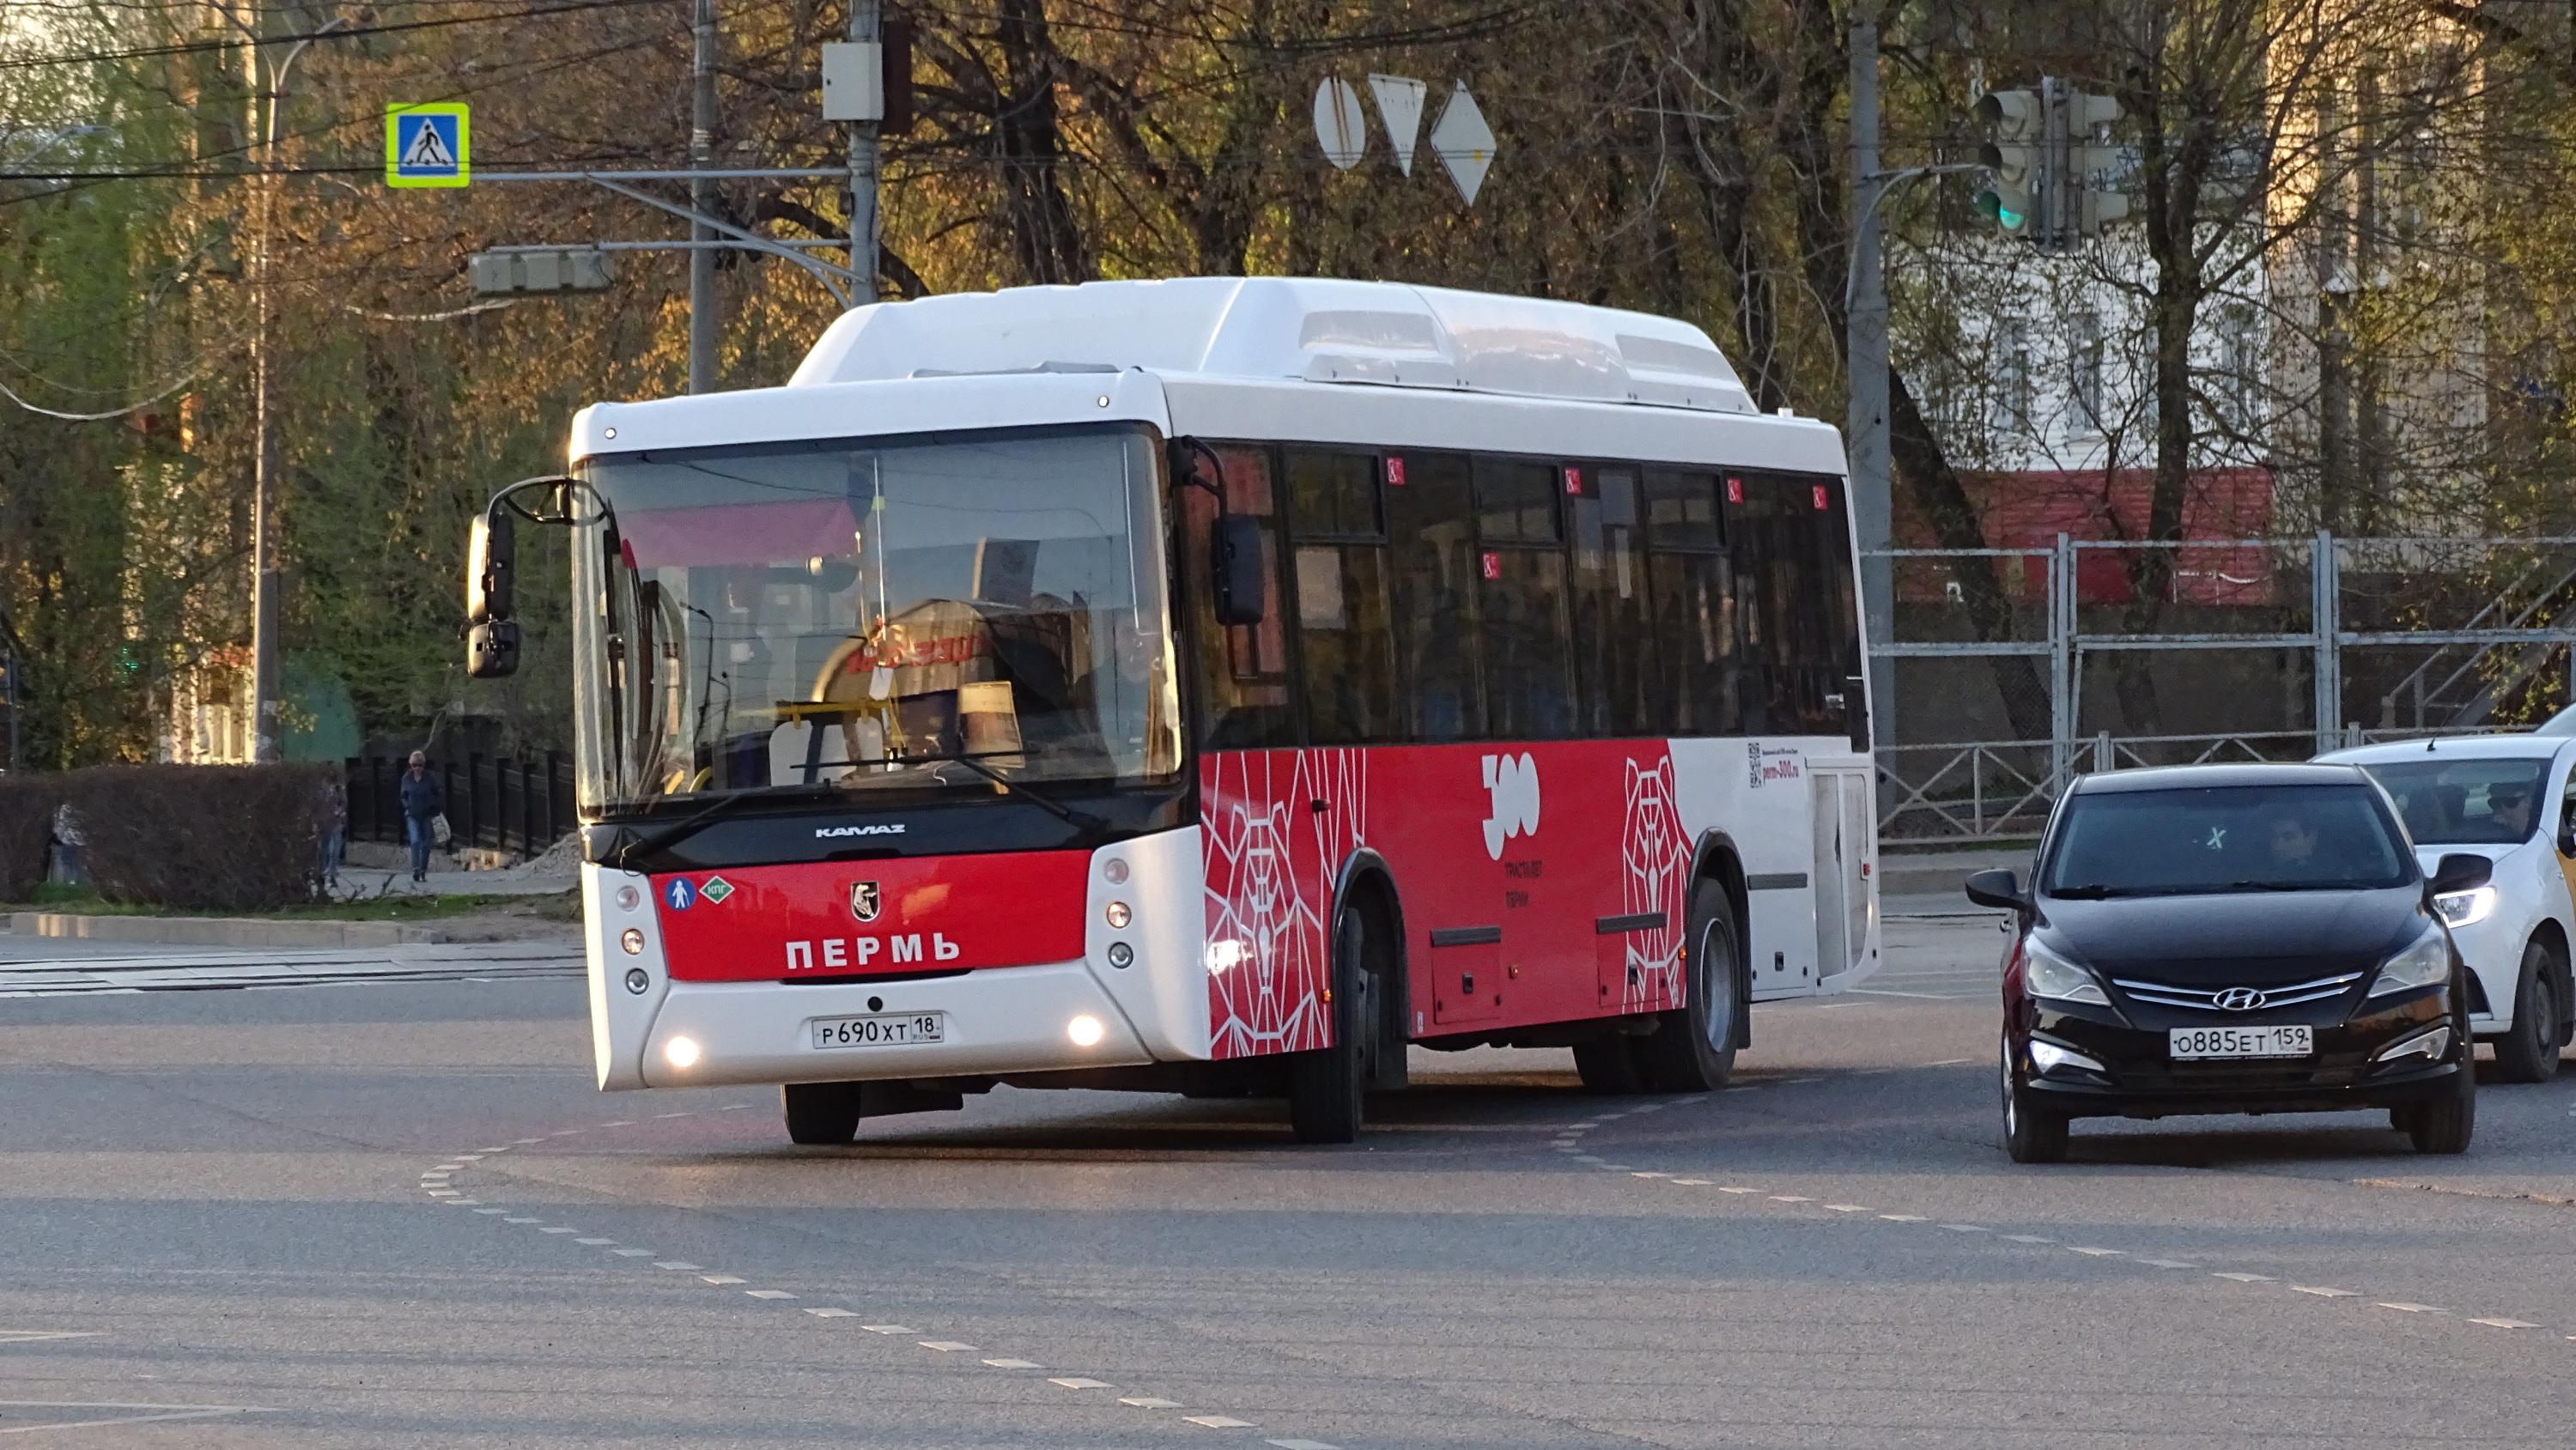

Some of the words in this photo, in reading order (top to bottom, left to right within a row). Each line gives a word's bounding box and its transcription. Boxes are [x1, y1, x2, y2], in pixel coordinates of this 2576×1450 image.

[816, 824, 905, 837] KAMAZ
[708, 885, 726, 895] КПГ
[786, 932, 960, 969] ПЕРМЬ
[914, 1016, 934, 1033] 18
[2273, 1028, 2306, 1045] 159
